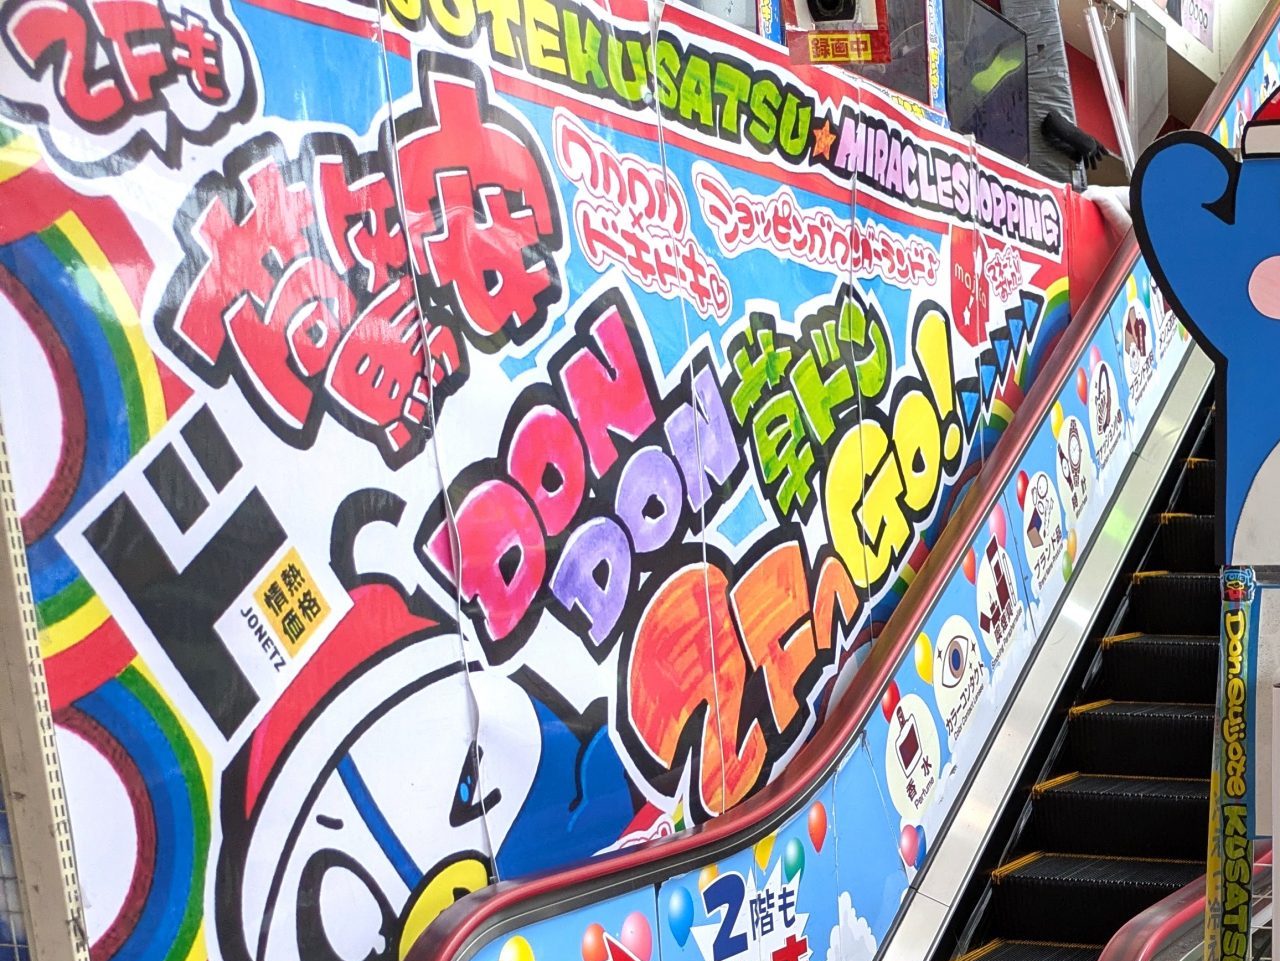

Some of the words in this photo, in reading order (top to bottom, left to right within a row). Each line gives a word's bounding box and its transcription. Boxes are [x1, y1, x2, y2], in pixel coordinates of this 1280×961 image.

[809, 36, 870, 59] 録画中
[564, 11, 811, 156] KUSATSU
[1033, 523, 1063, 580] ブランド品
[239, 605, 287, 673] JONETZ
[945, 660, 985, 734] カラーコンタクト
[905, 755, 933, 802] 香水
[914, 776, 935, 810] Perfume
